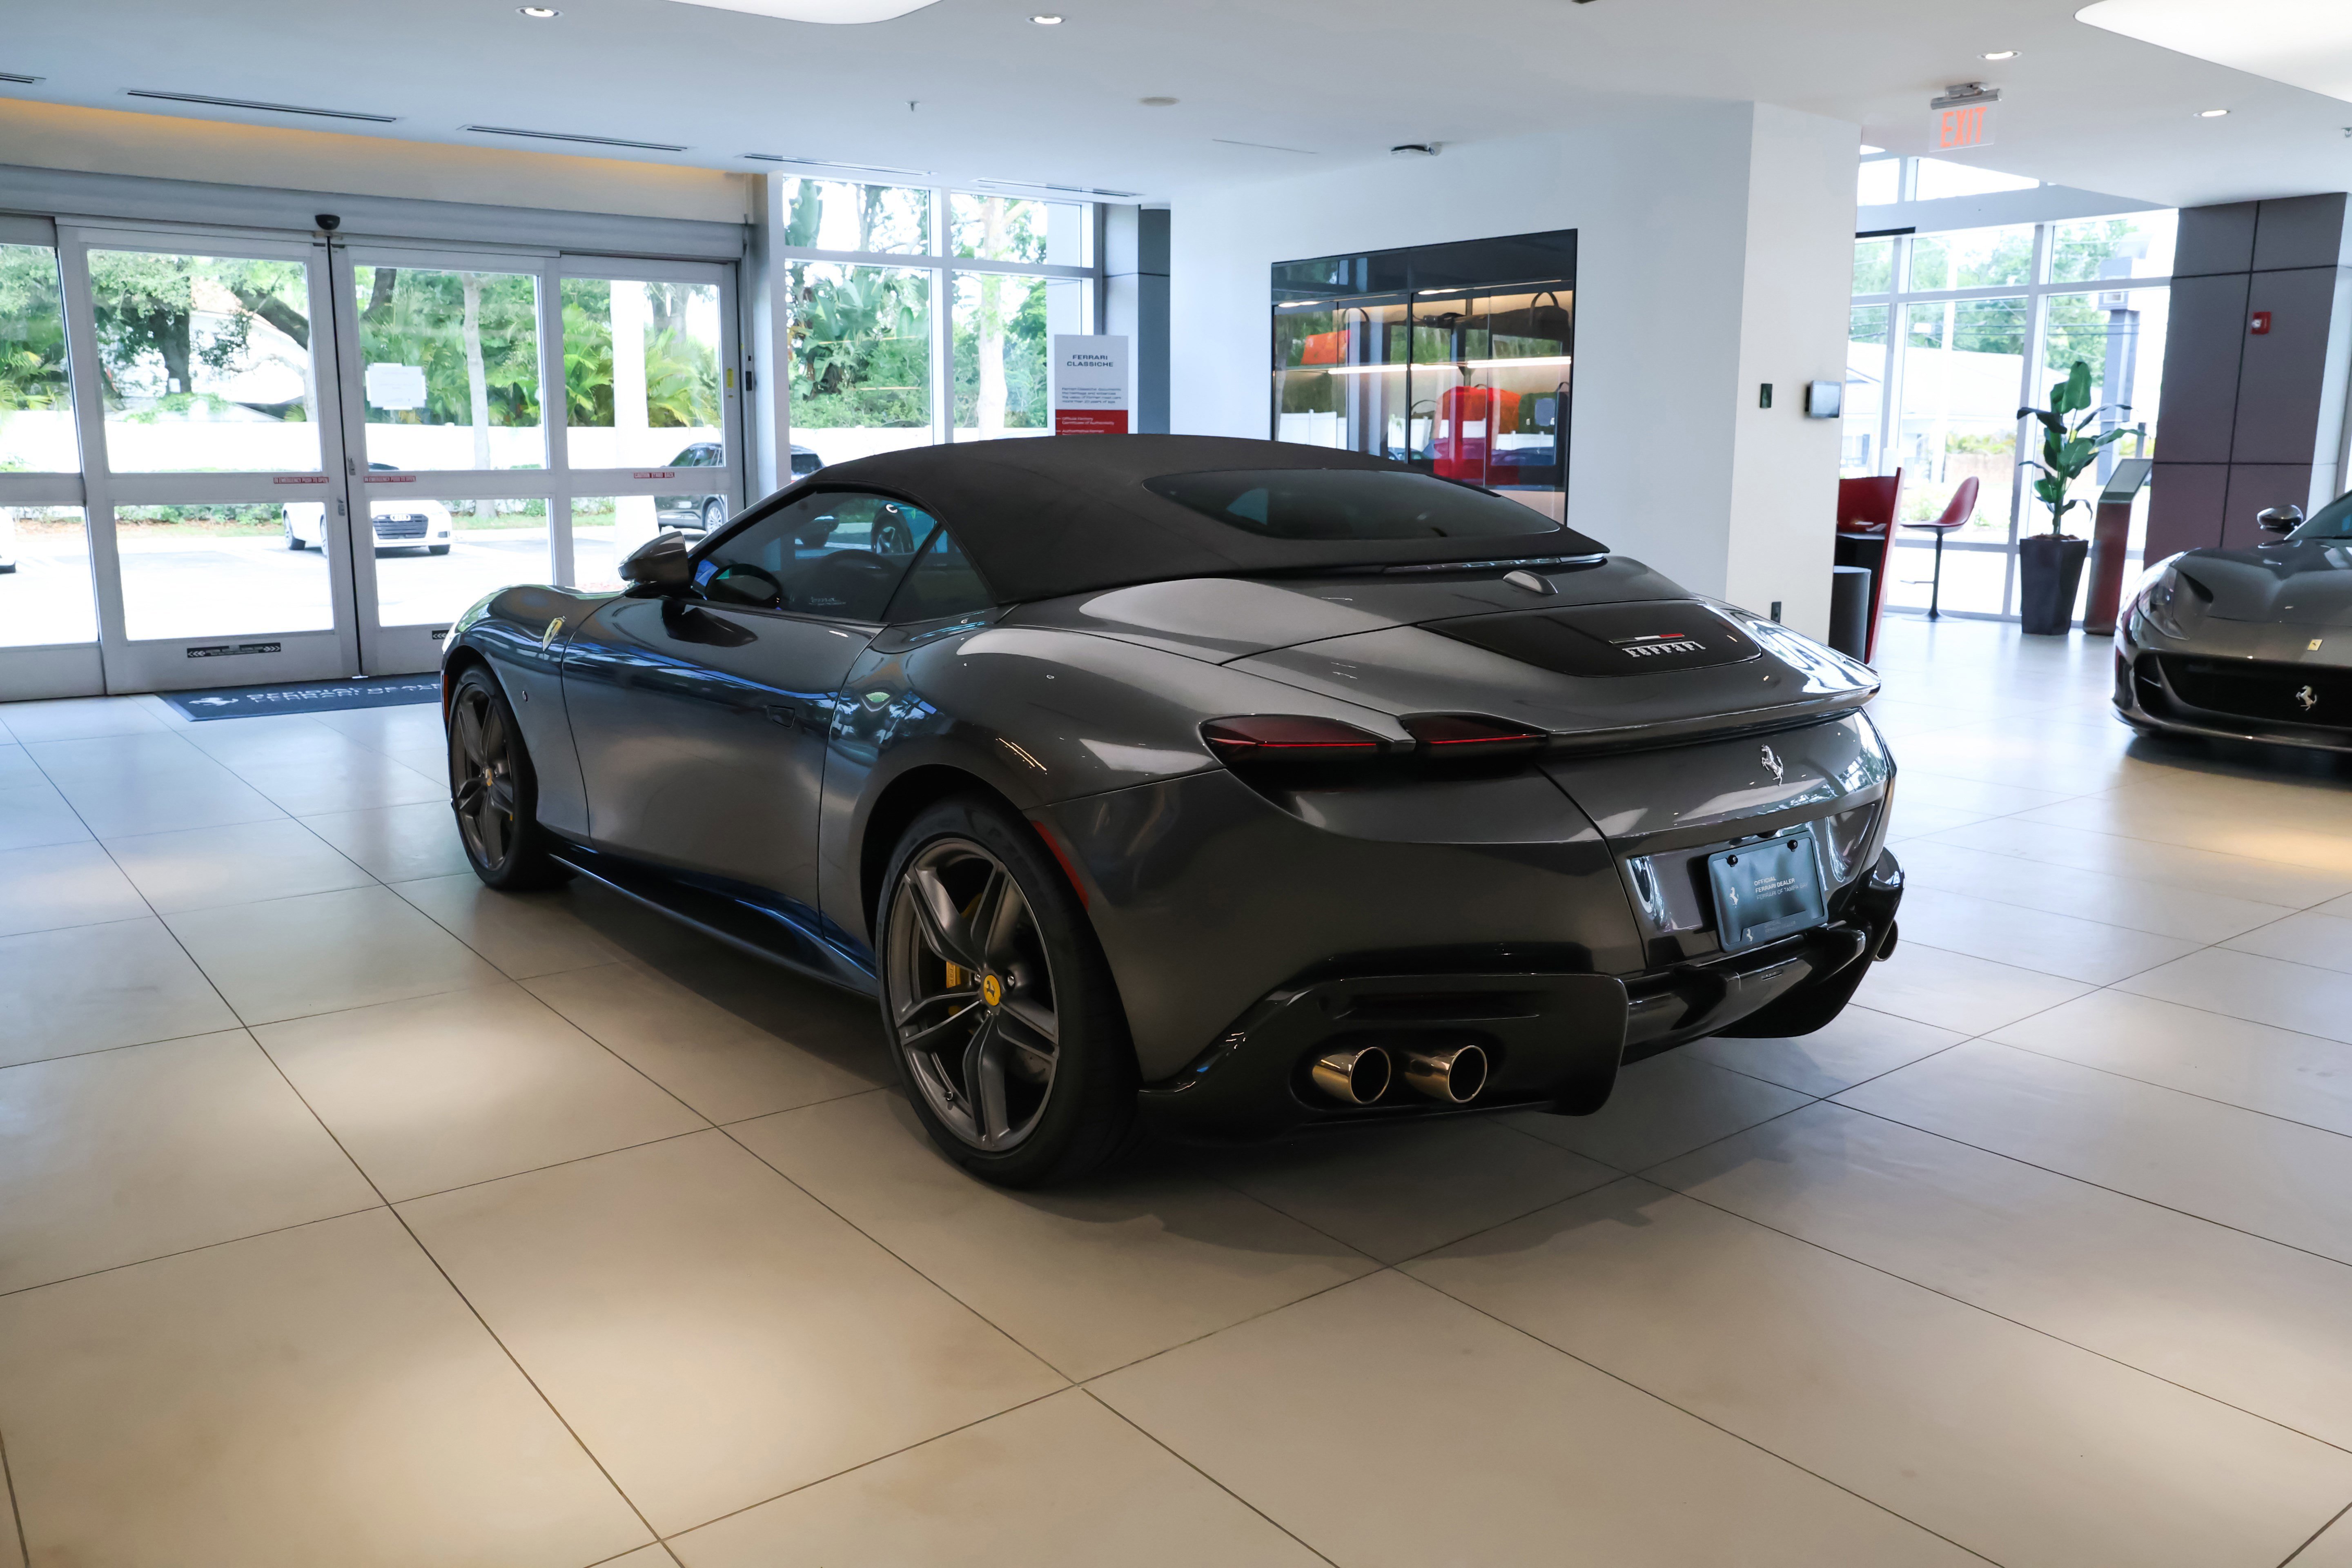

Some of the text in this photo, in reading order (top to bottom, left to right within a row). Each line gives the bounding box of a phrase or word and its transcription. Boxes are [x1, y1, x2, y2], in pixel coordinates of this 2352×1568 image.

[1940, 107, 1987, 148] EXIT
[1622, 641, 1706, 658] Ferrari
[1754, 876, 1777, 886] OFFICIAL
[1755, 878, 1795, 893] FERRARI DEALER
[1757, 891, 1777, 900] FERRARI
